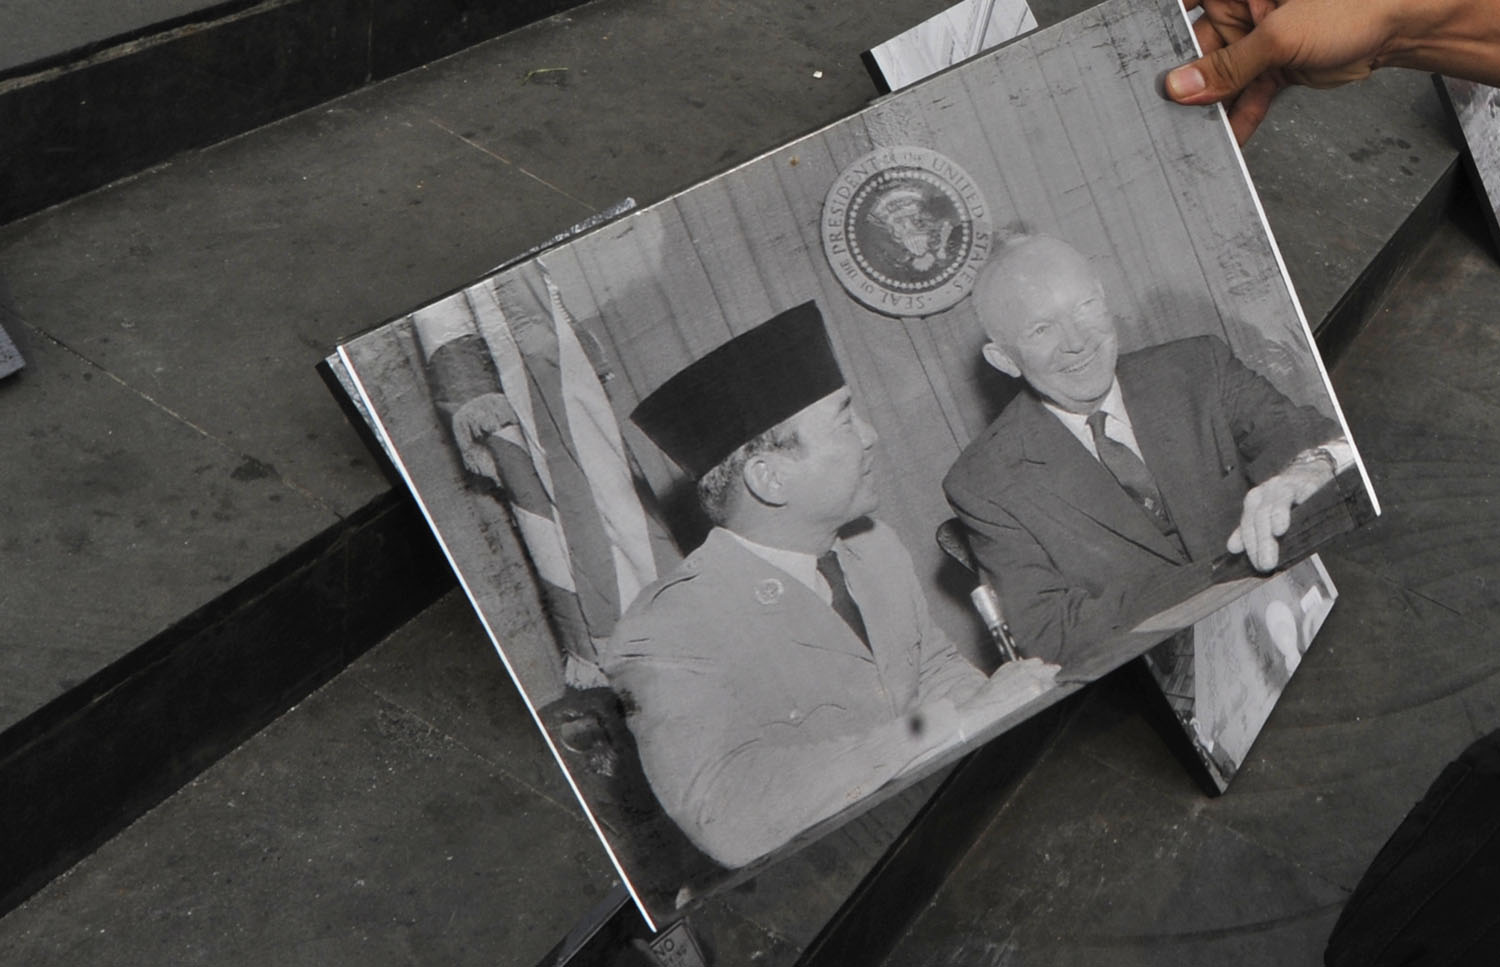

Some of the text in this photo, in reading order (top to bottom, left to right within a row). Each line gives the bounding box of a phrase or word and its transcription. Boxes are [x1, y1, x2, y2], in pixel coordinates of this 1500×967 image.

[828, 155, 879, 256] PRESIDENT
[932, 157, 985, 219] UNITED
[952, 232, 990, 292] STATES
[881, 290, 925, 309] SEAL
